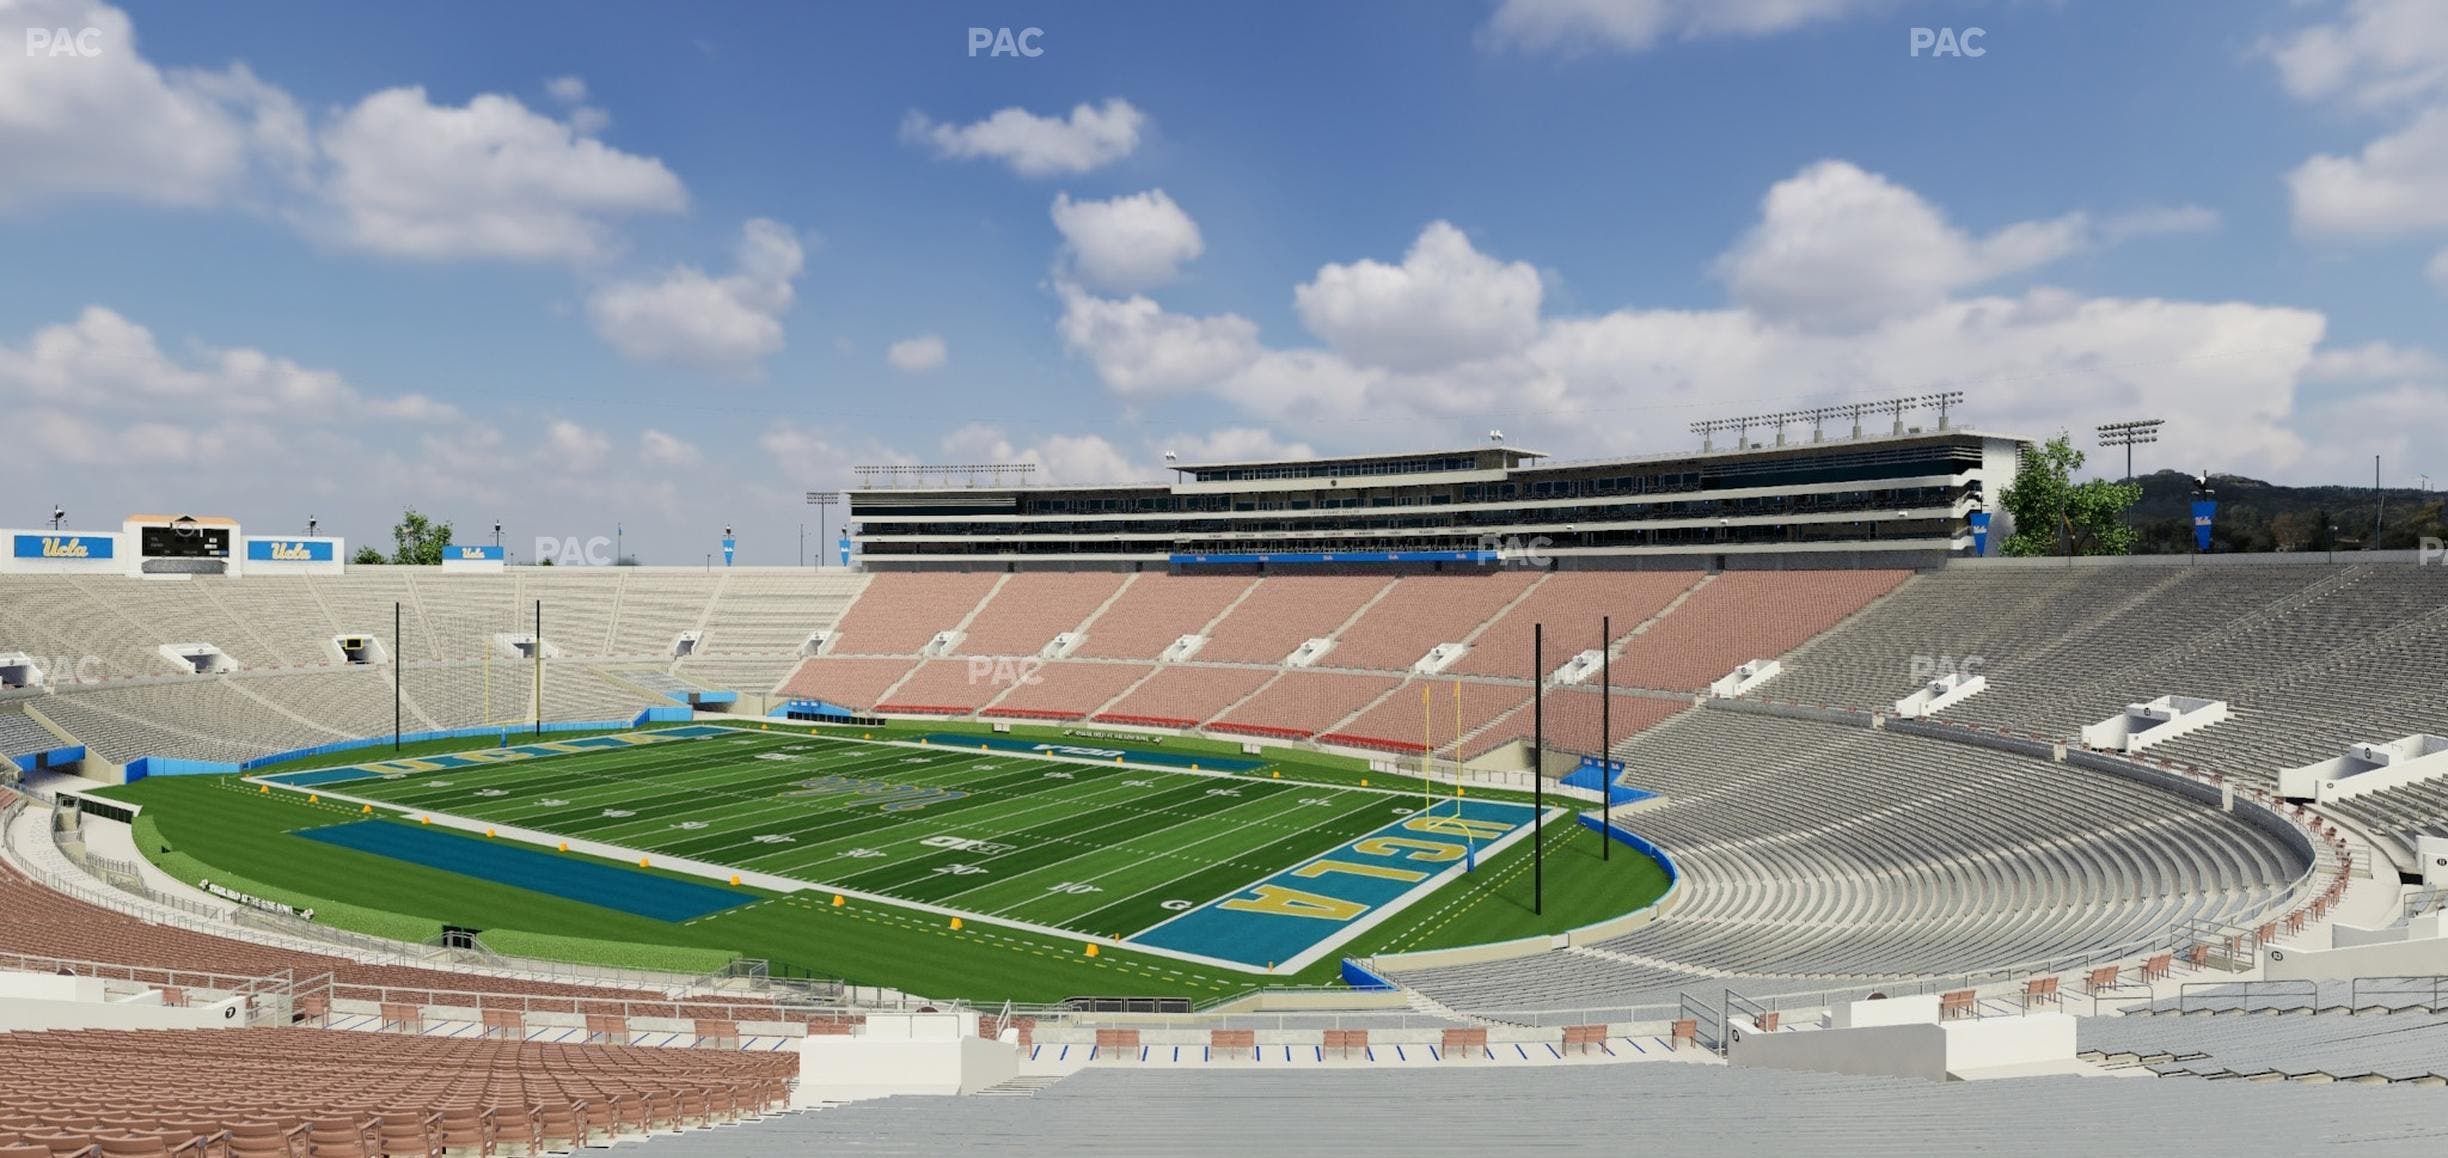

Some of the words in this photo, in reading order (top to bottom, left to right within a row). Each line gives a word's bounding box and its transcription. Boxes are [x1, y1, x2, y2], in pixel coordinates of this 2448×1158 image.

[42, 538, 89, 557] Ucla
[271, 542, 312, 560] Ucla
[1215, 815, 1517, 921] UCLA
